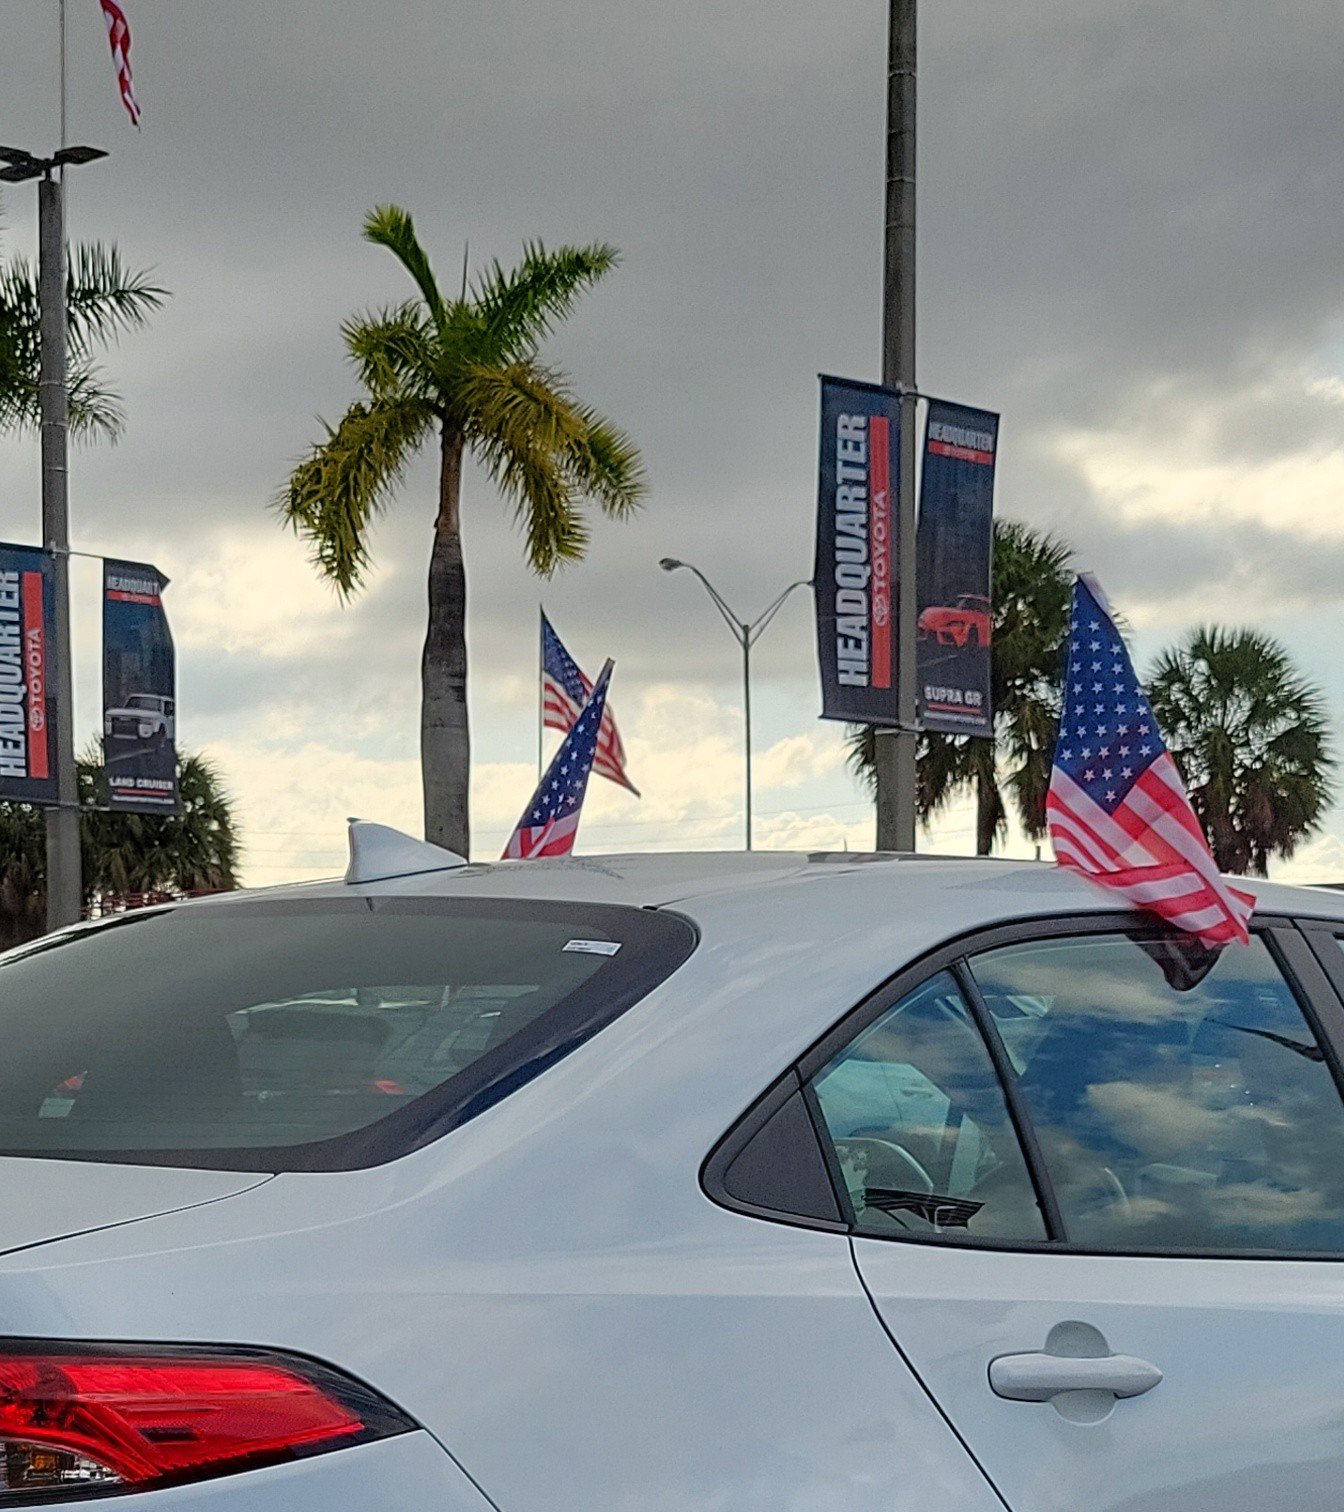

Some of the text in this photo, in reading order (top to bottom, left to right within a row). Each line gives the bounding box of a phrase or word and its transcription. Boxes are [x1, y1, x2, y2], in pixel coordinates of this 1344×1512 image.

[835, 413, 869, 687] HEADQUARTER
[871, 491, 887, 589] TOYOTA
[27, 628, 43, 704] TOYOTA
[924, 685, 983, 706] SUPRA GR
